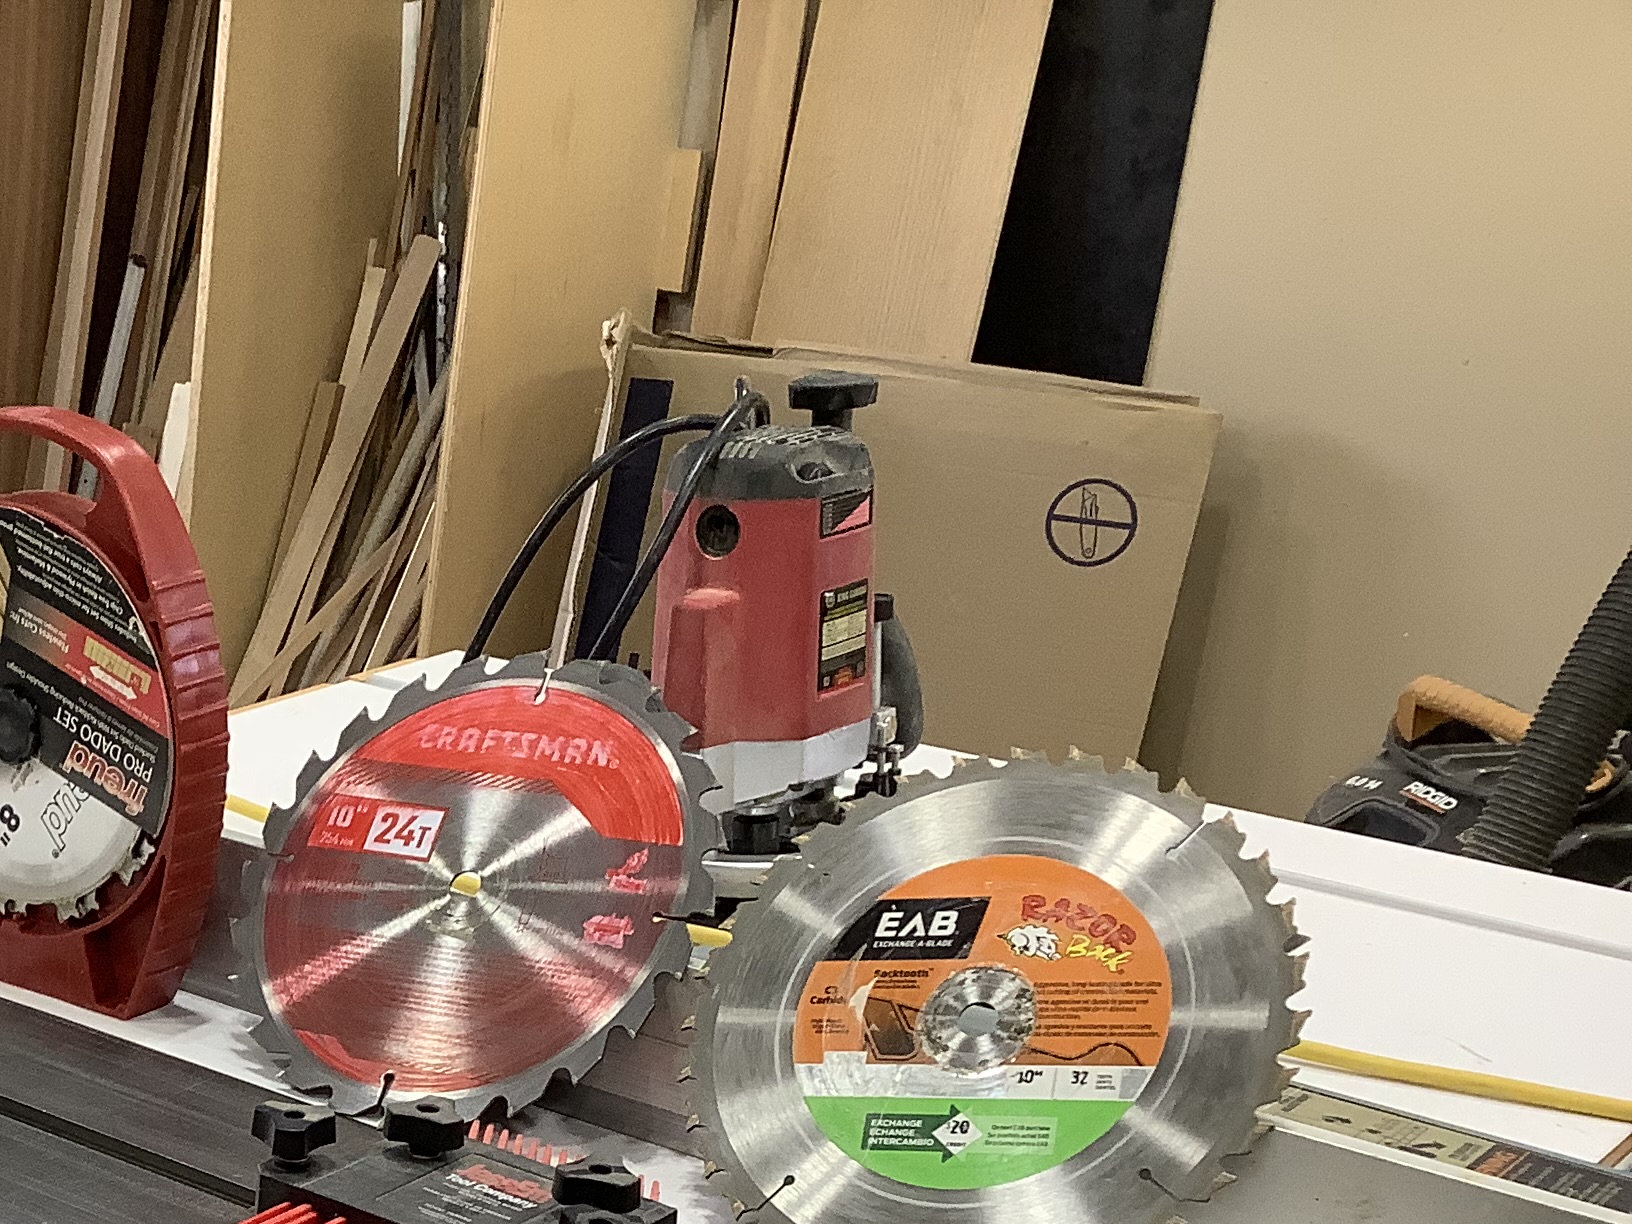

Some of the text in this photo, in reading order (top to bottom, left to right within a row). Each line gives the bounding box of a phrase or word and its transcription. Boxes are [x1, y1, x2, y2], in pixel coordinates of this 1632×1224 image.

[19, 616, 38, 634] Cuts
[52, 705, 154, 783] PRO DADO SET
[420, 724, 613, 767] CRAFTSMAN
[59, 739, 148, 817] freud
[1402, 781, 1458, 810] RIDGID
[39, 781, 89, 851] eud
[326, 804, 368, 828] 10"
[373, 811, 432, 849] 24T
[1021, 895, 1137, 953] RAZOR
[870, 1119, 923, 1128] EXCHANGE
[868, 1137, 934, 1147] INTERCAMBIO
[446, 1173, 476, 1186] Tool
[474, 1184, 537, 1208] Company
